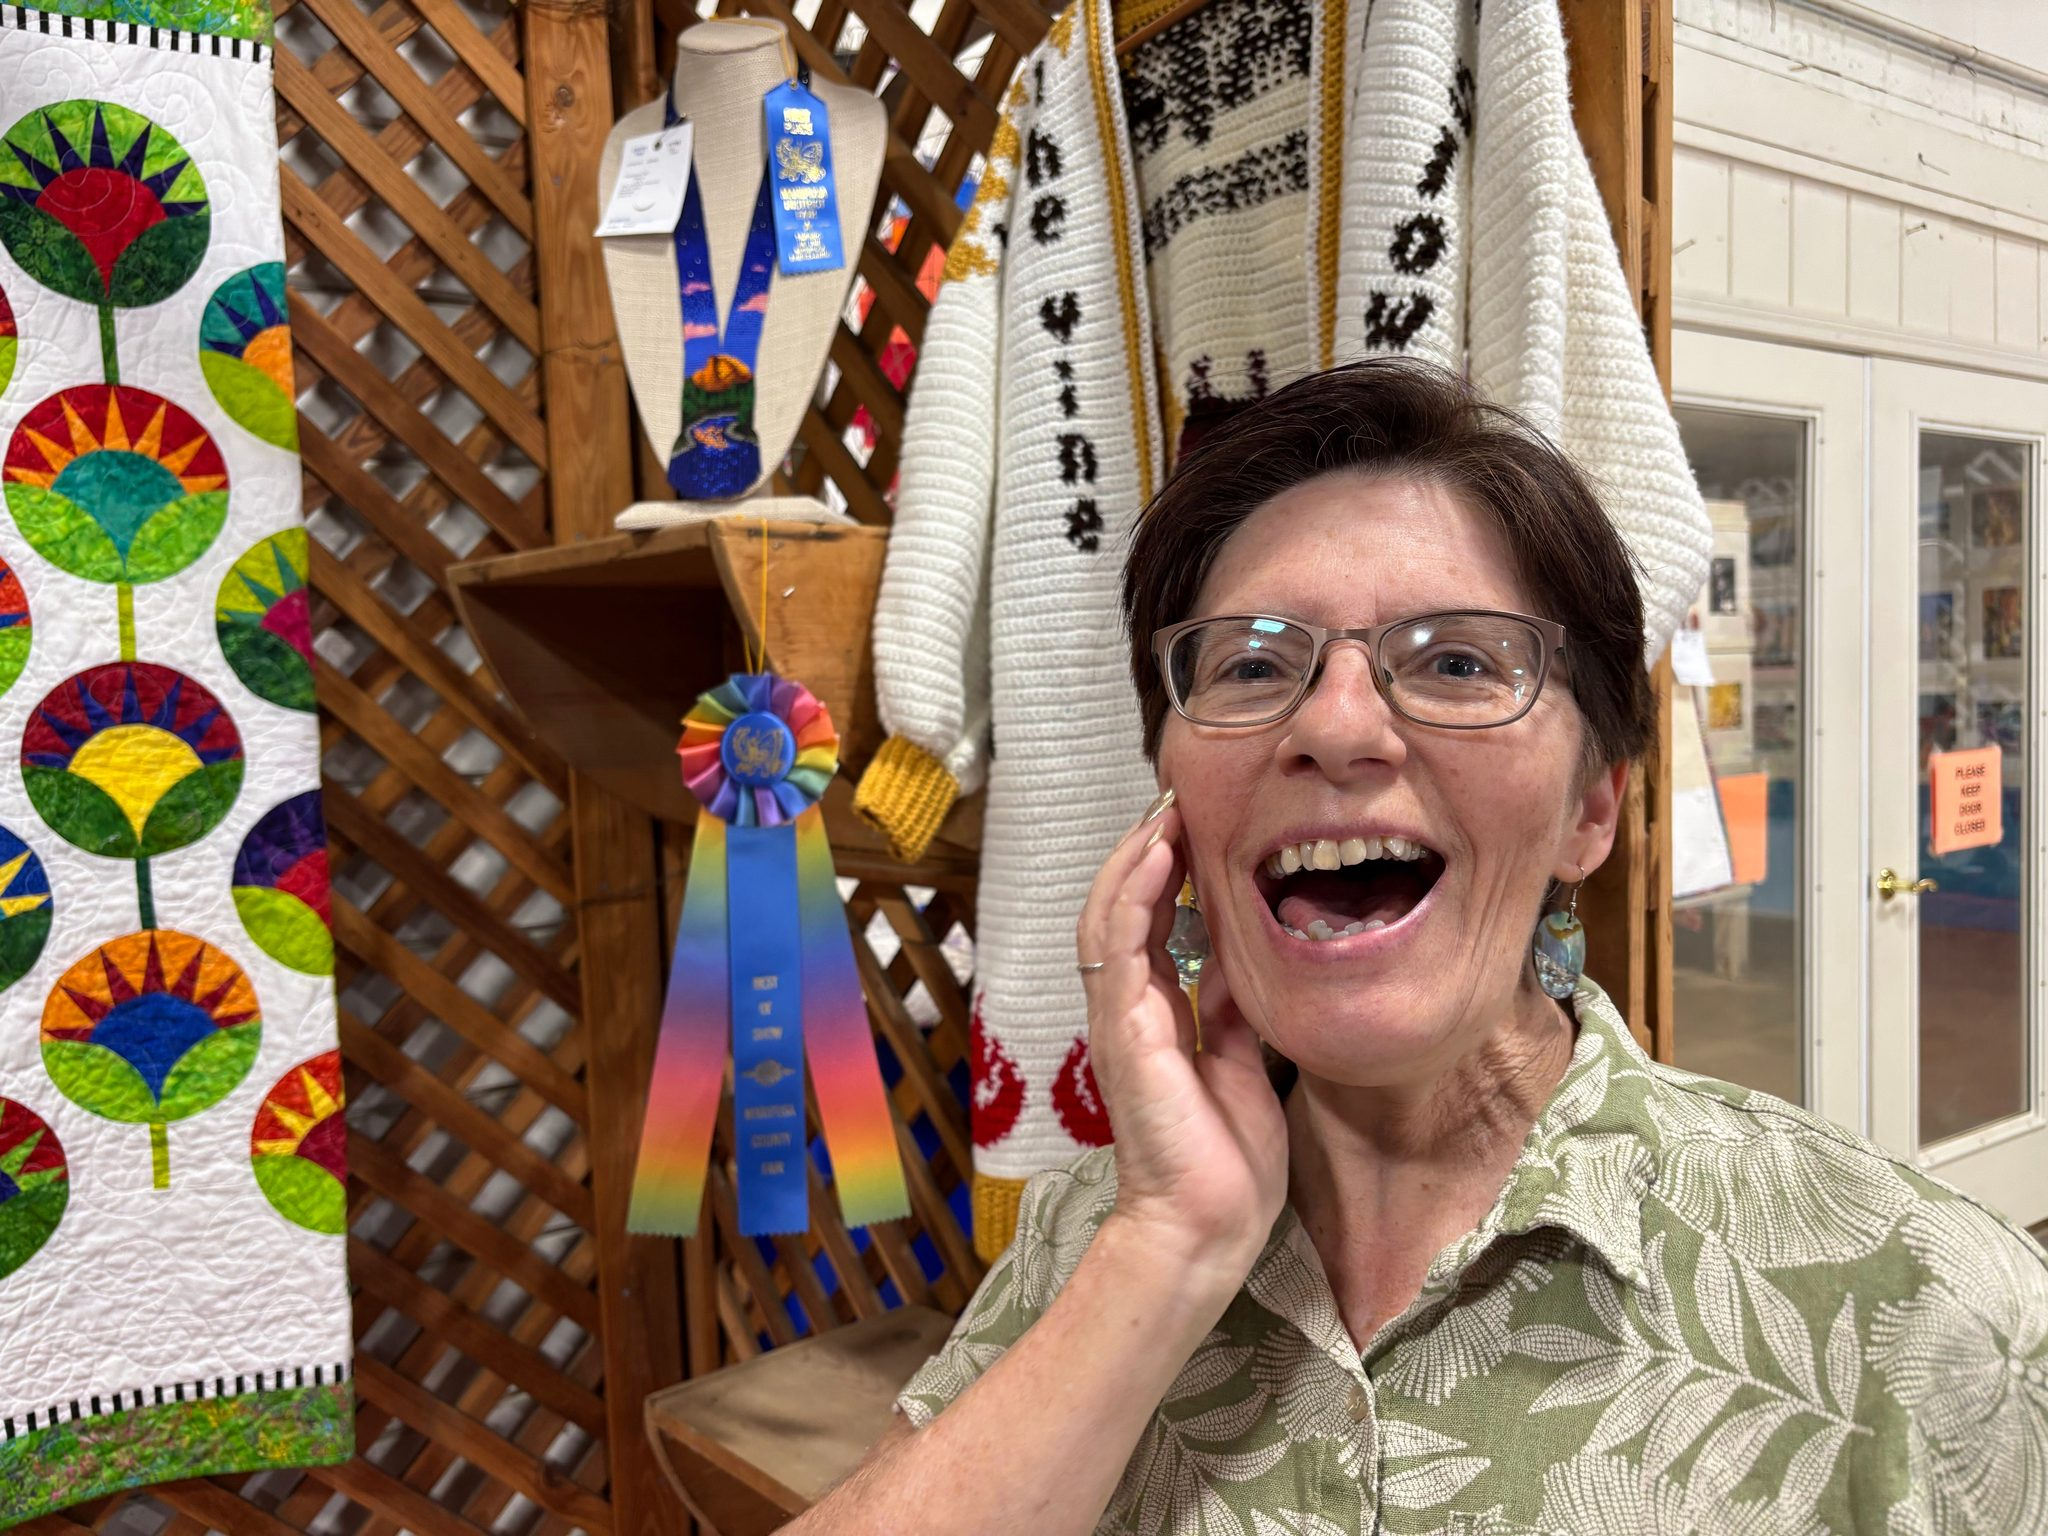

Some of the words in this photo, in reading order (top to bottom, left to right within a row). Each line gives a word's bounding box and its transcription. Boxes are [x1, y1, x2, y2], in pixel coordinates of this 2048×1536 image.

[1955, 763, 1986, 779] PLEASE
[1960, 784, 1981, 798] KEEP
[1959, 801, 1983, 816] DOOR
[1954, 820, 1986, 836] CLOSED
